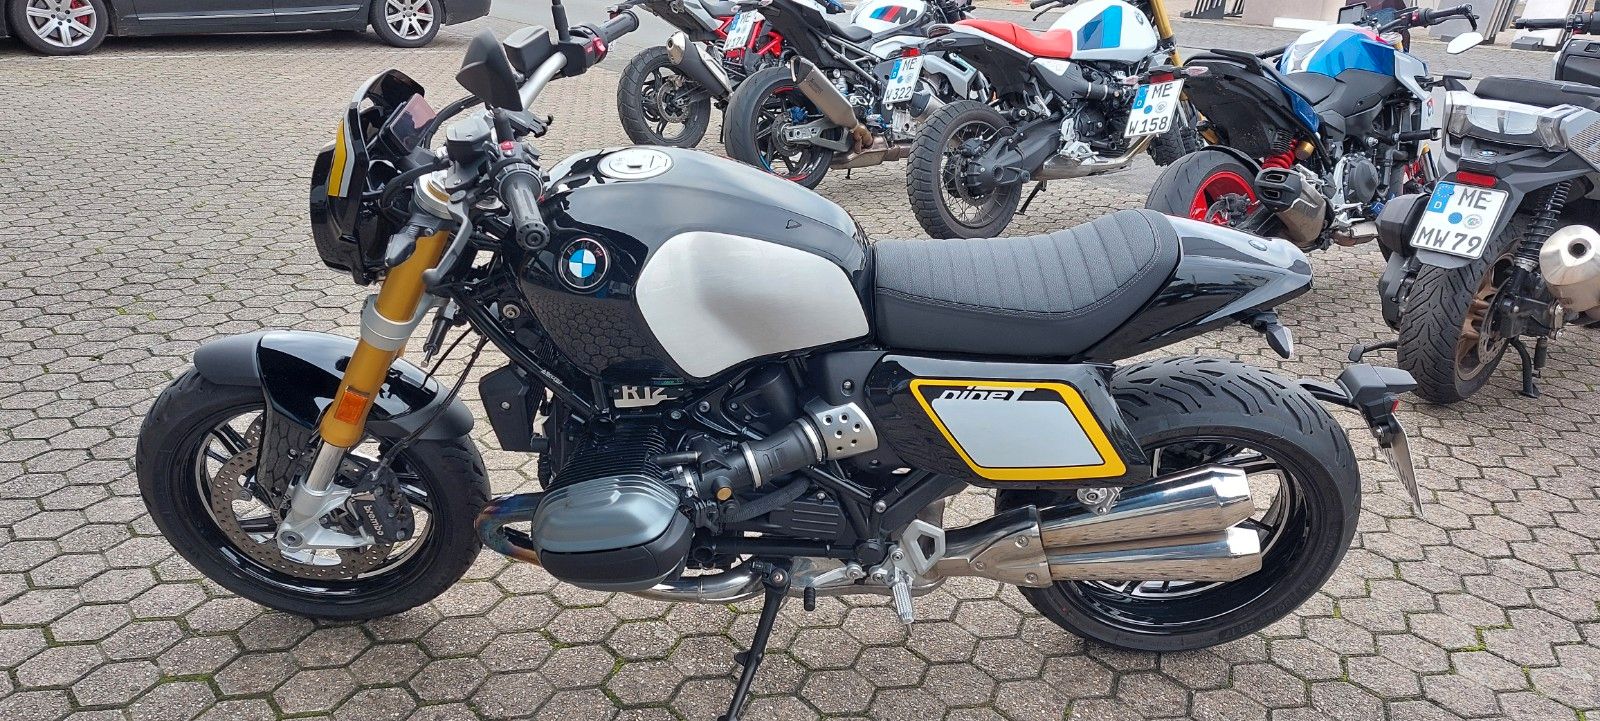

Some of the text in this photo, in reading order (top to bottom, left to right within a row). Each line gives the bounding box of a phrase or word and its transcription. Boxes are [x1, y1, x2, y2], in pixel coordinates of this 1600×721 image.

[902, 57, 918, 71] ME
[892, 86, 912, 100] 322
[1151, 82, 1173, 99] ME
[1128, 116, 1169, 135] W 158
[1457, 187, 1492, 210] ME
[1415, 226, 1483, 254] MW 79
[938, 385, 1037, 402] nineT
[363, 504, 384, 536] brembo
